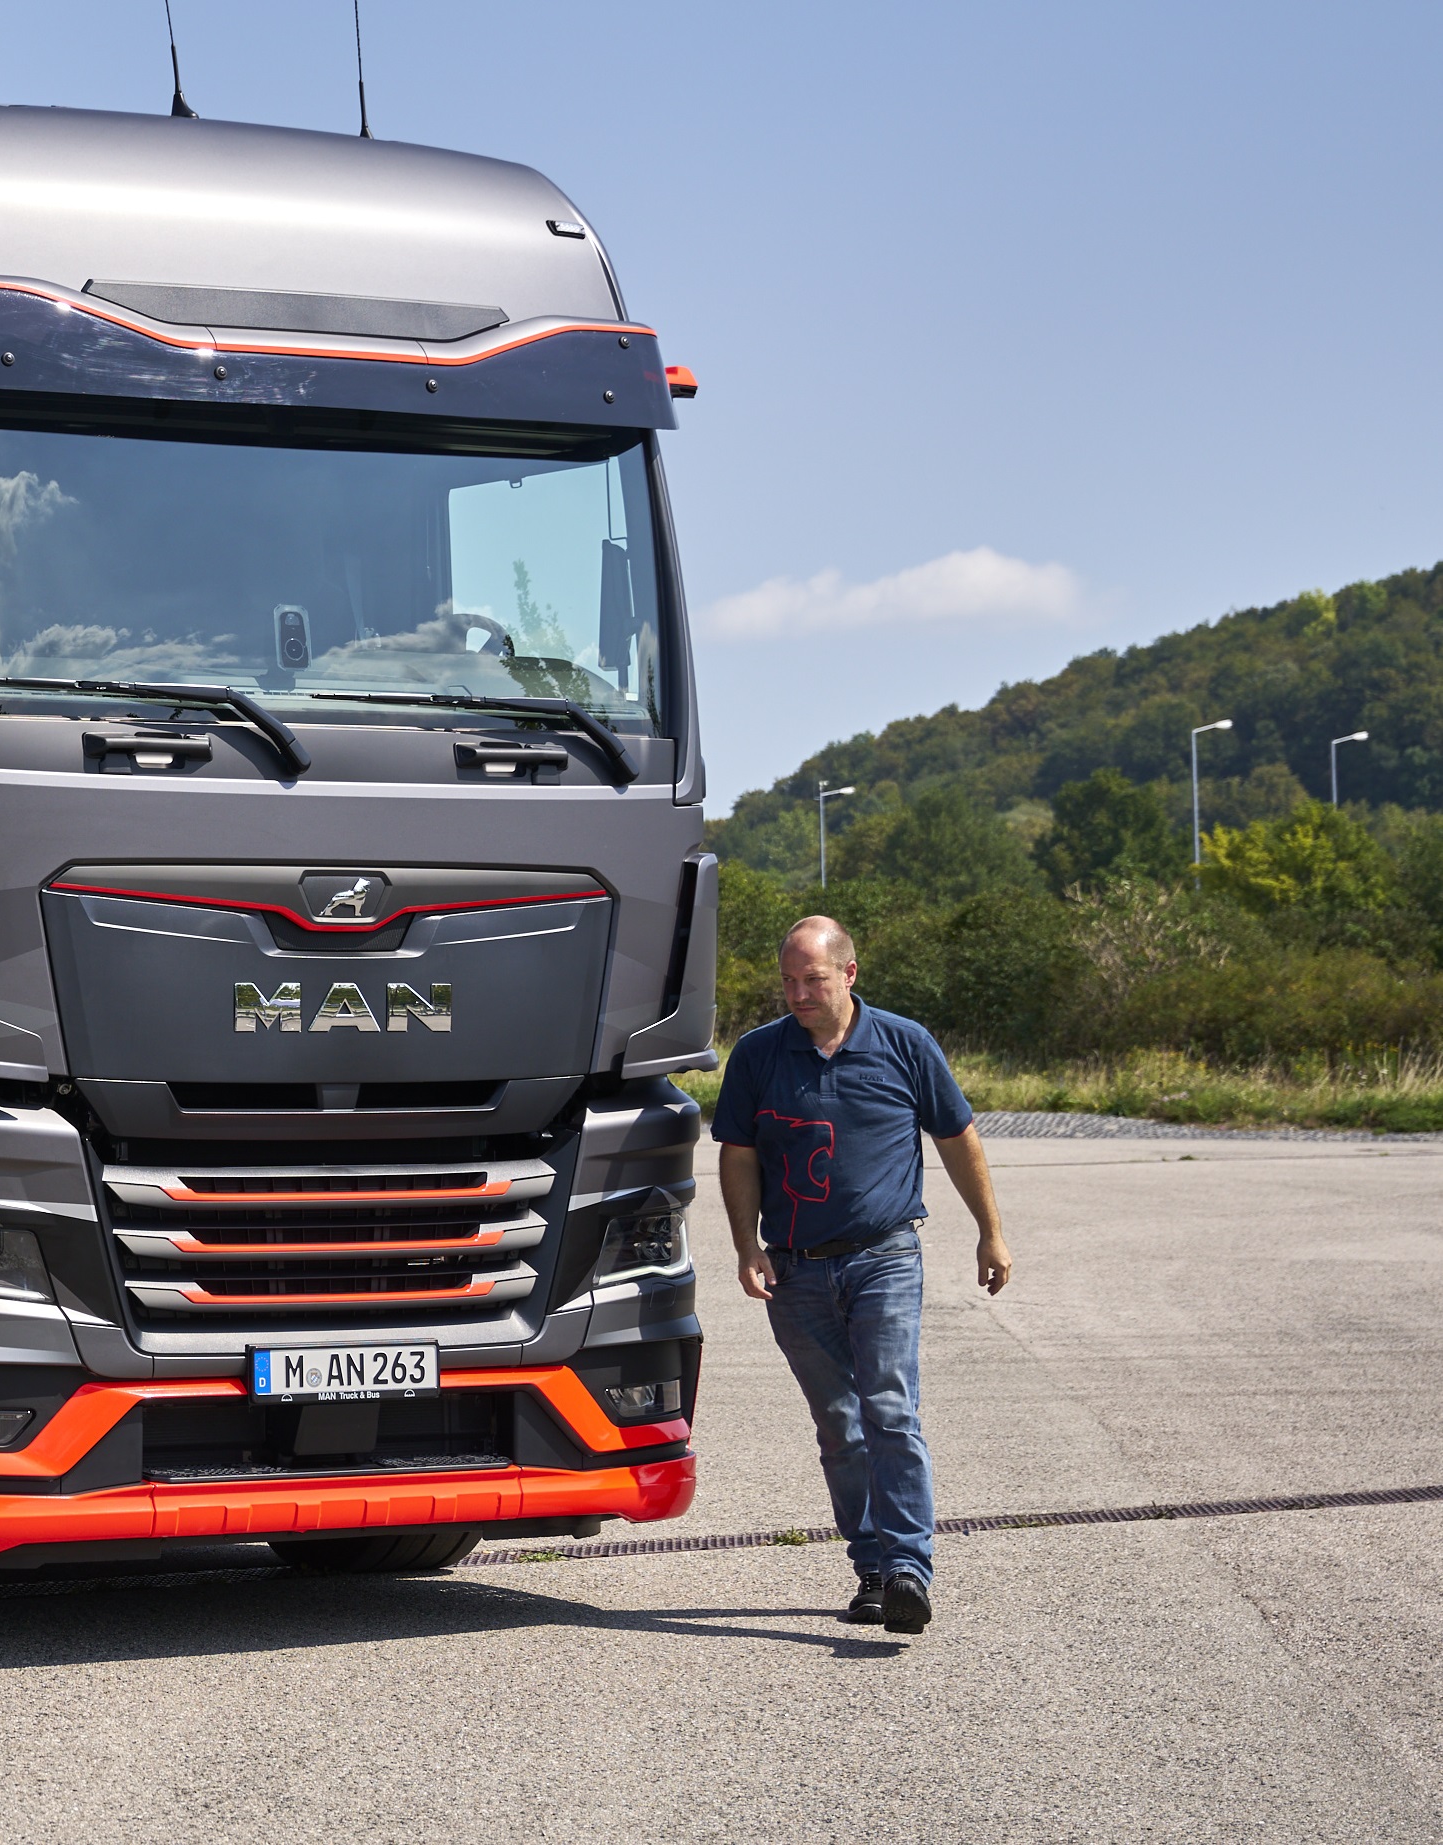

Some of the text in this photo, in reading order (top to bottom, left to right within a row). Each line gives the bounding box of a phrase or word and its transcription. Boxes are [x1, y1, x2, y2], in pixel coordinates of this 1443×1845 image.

[234, 982, 452, 1033] MAN
[859, 1073, 885, 1083] MAN
[259, 1350, 426, 1388] D M AN 263
[318, 1390, 380, 1400] MAN Truck & Bus
